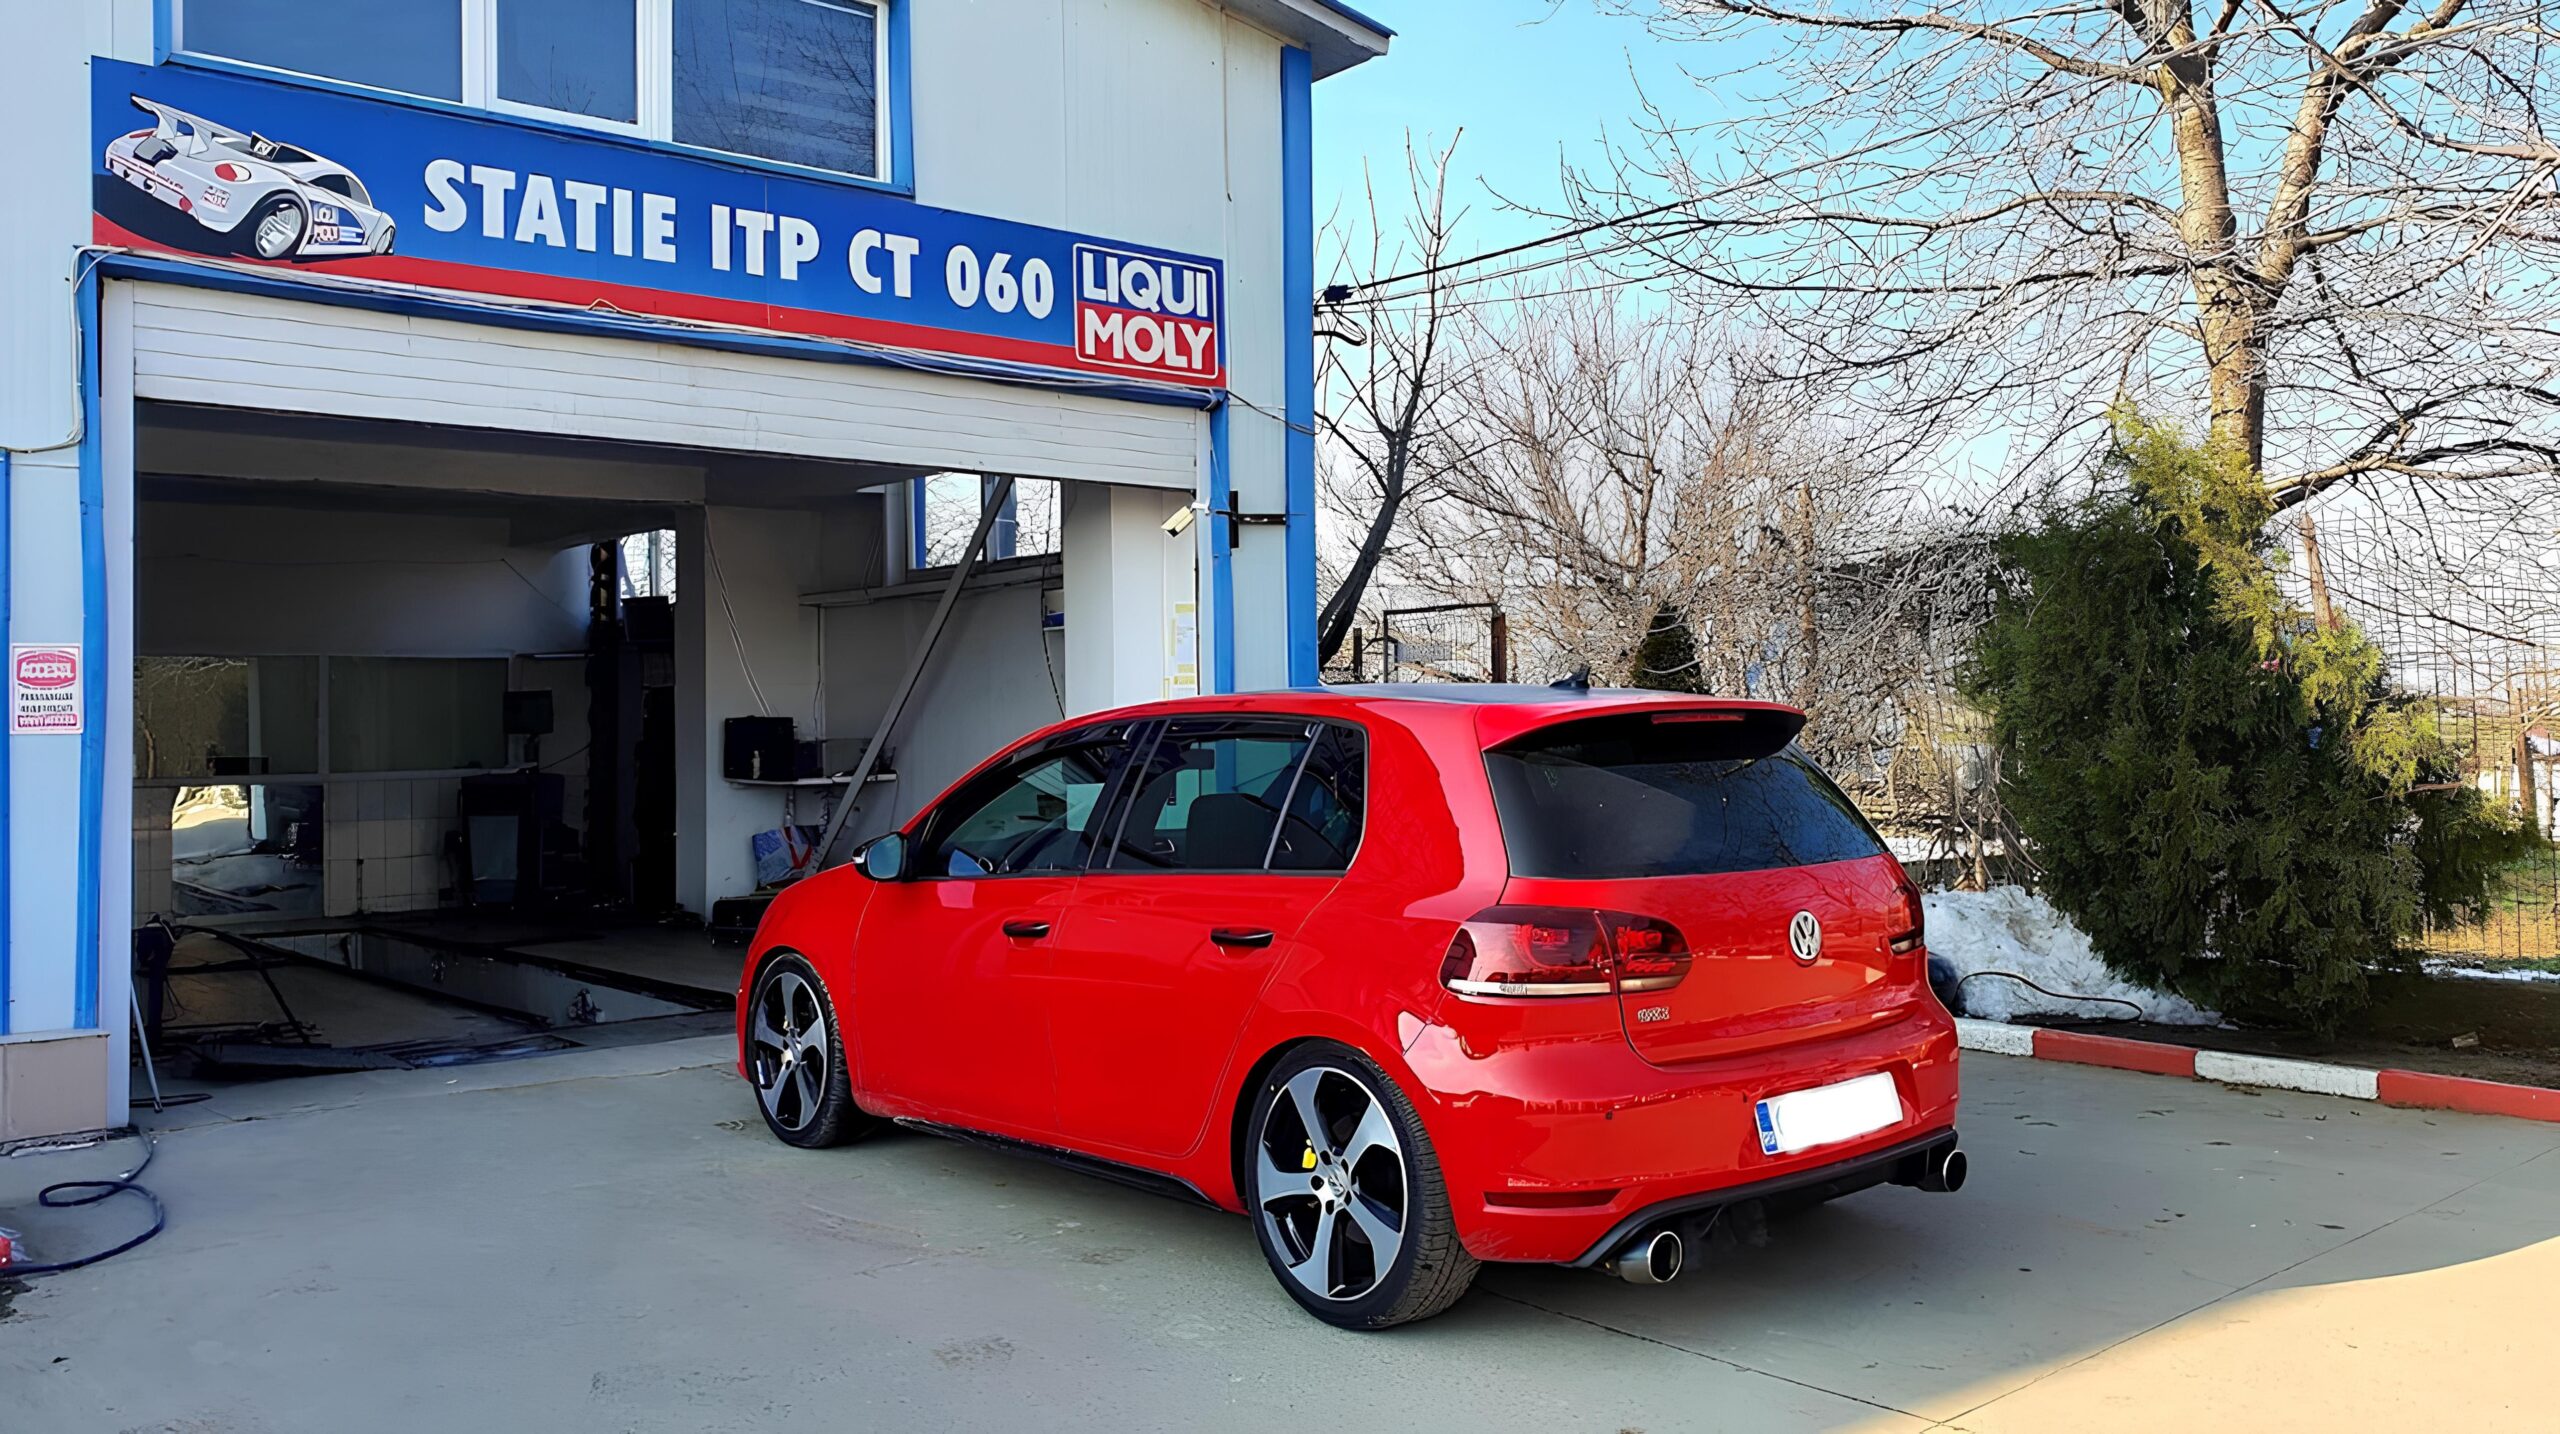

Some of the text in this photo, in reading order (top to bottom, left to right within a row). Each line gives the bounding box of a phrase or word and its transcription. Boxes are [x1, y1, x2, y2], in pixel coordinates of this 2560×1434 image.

[424, 158, 677, 264] STATIE
[710, 203, 820, 281] ITP
[847, 228, 920, 298] CT
[945, 244, 1054, 320] 060
[1081, 250, 1208, 318] LIQUI
[1084, 307, 1214, 370] MOLY
